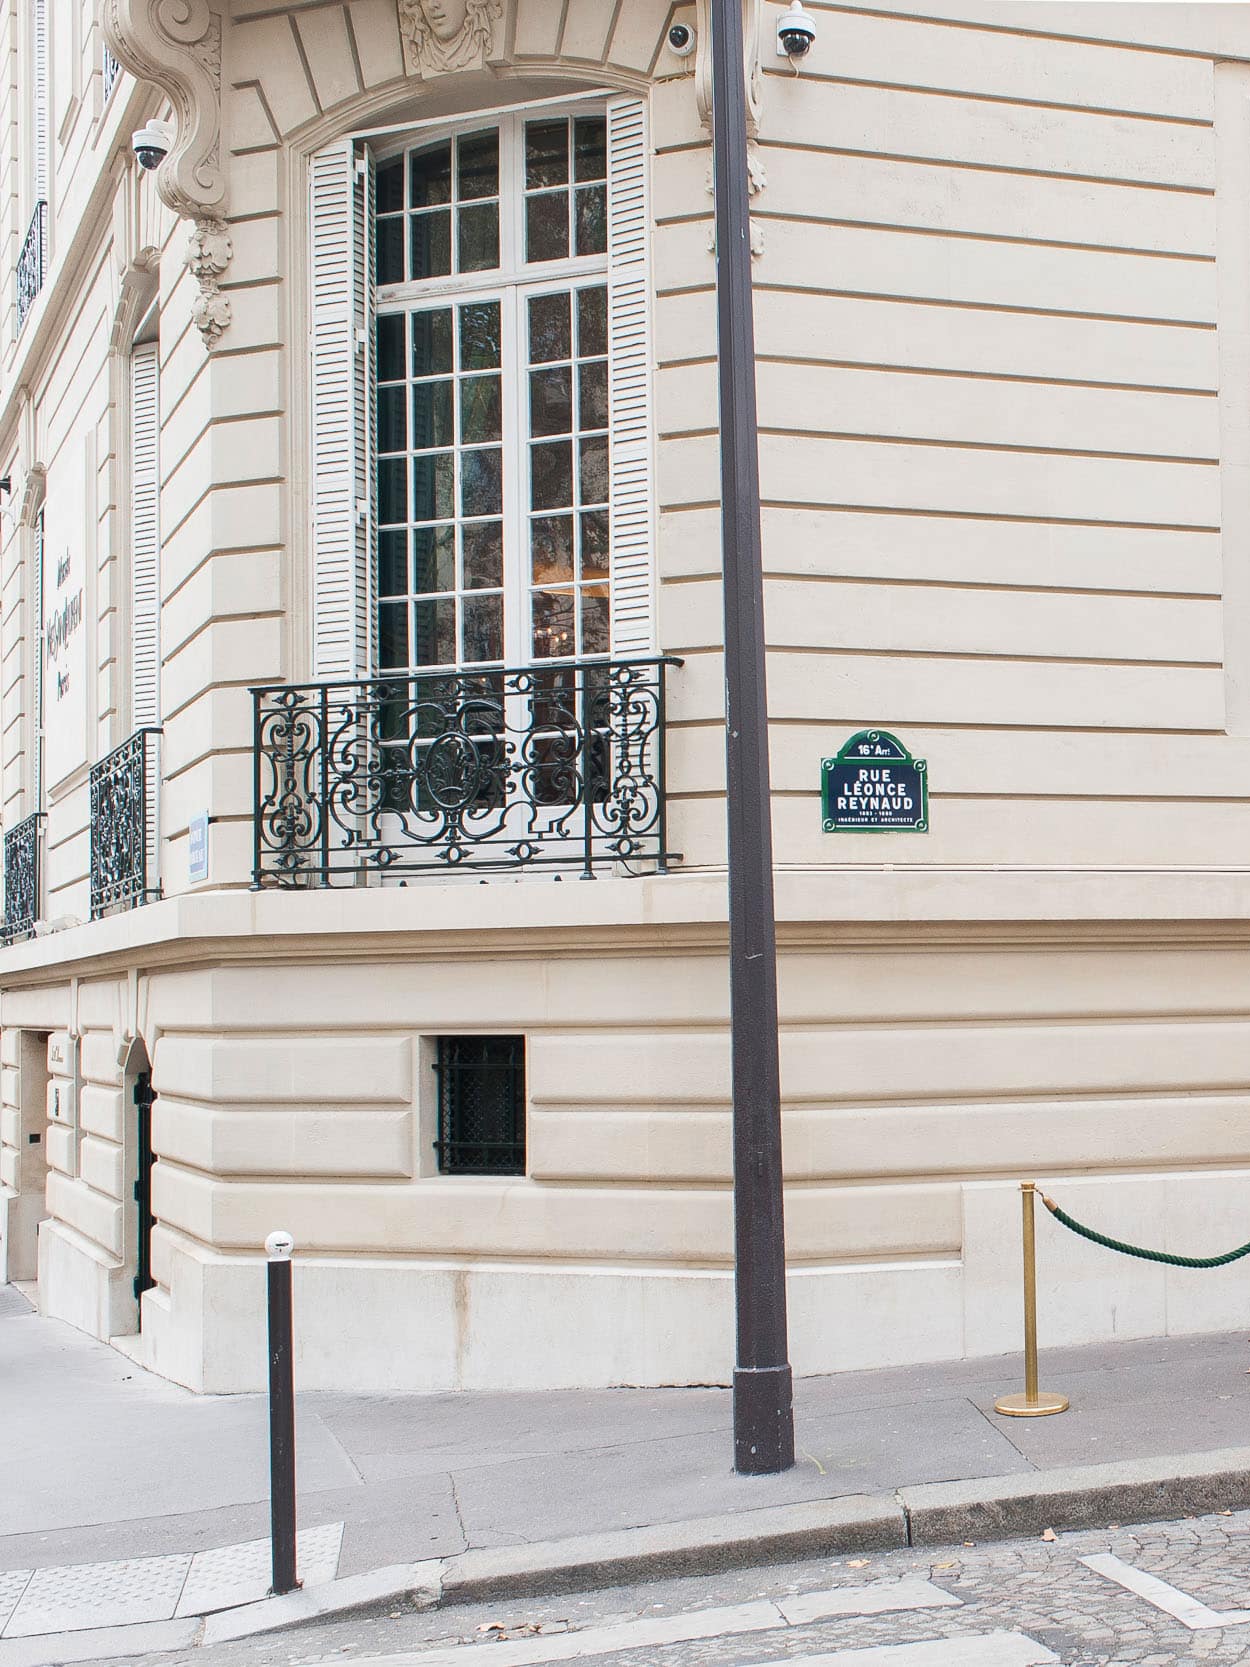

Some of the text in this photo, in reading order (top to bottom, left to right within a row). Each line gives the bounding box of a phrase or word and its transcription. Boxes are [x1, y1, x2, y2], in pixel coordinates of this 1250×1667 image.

[859, 769, 891, 782] RUE
[843, 780, 906, 796] LÉONCE
[837, 797, 913, 810] REYNAUD
